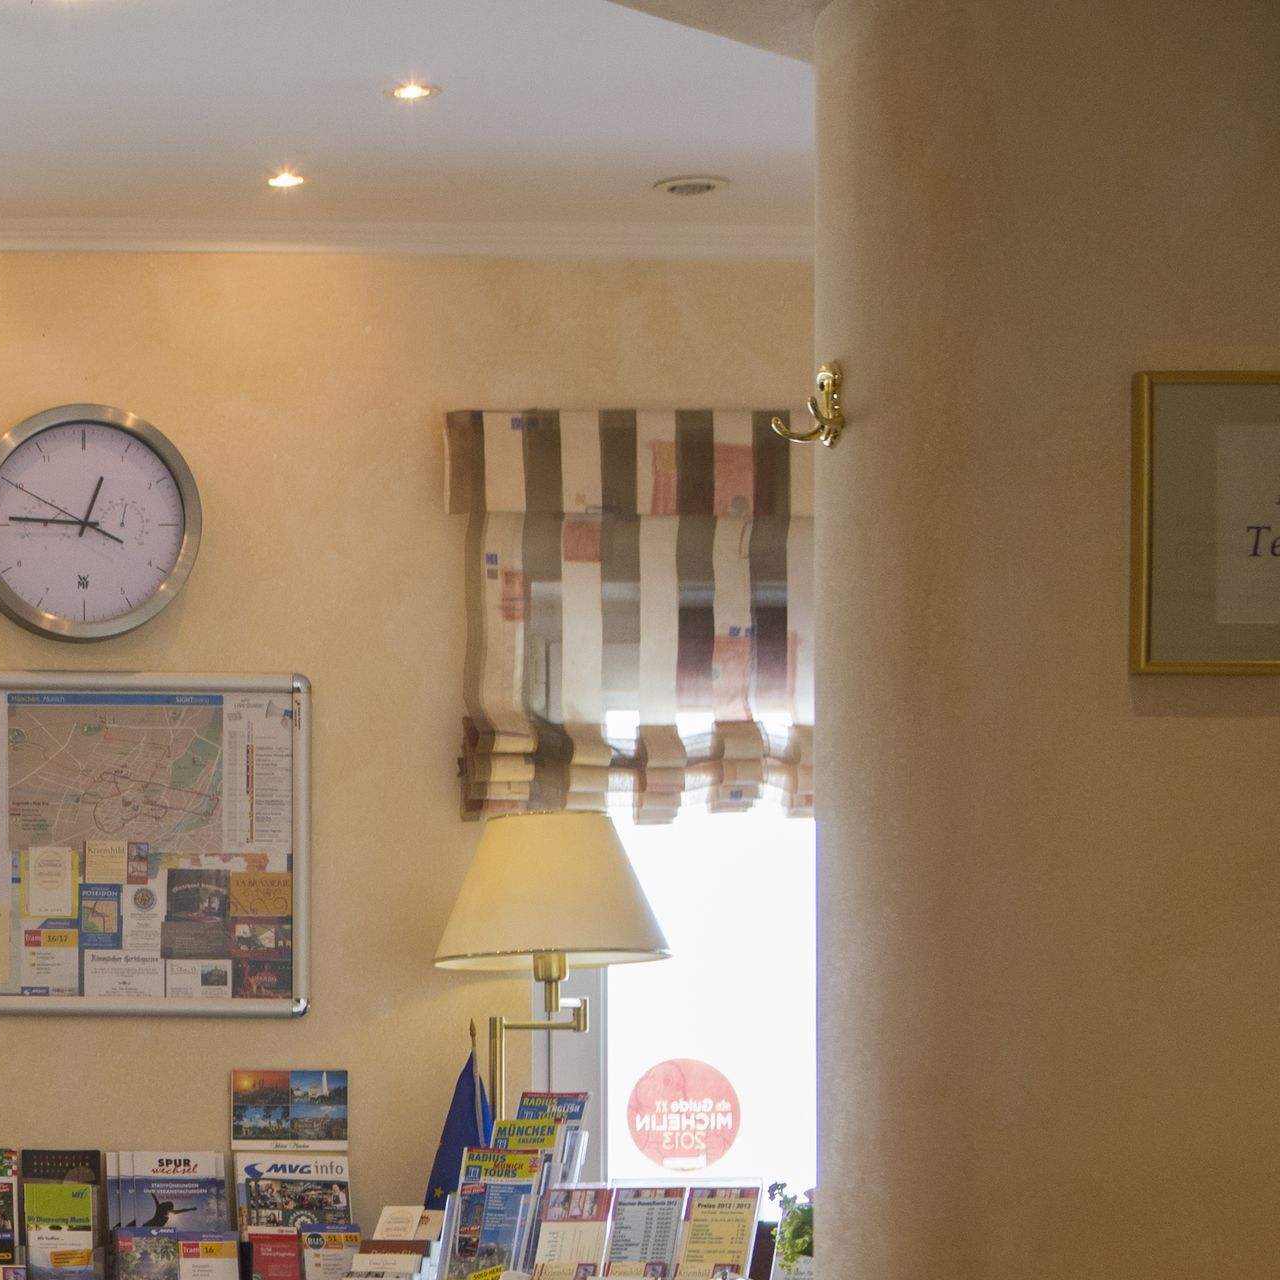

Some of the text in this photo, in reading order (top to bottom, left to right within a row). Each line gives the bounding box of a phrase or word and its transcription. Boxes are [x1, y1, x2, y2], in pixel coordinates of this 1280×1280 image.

[42, 455, 51, 463] 11
[47, 935, 69, 943] 16/17
[523, 1098, 558, 1106] RADIUS
[547, 1103, 580, 1112] ENGLISH
[496, 1123, 555, 1137] MÜNCHEN
[158, 1158, 191, 1167] SPUR
[468, 1153, 506, 1163] RADIUS
[150, 1163, 199, 1174] wechsel
[266, 1160, 344, 1175] MVG info
[493, 1162, 524, 1170] MUNICH
[483, 1169, 517, 1178] TOURS
[307, 1236, 324, 1245] BUS
[473, 1266, 502, 1280] SOLD HERE
